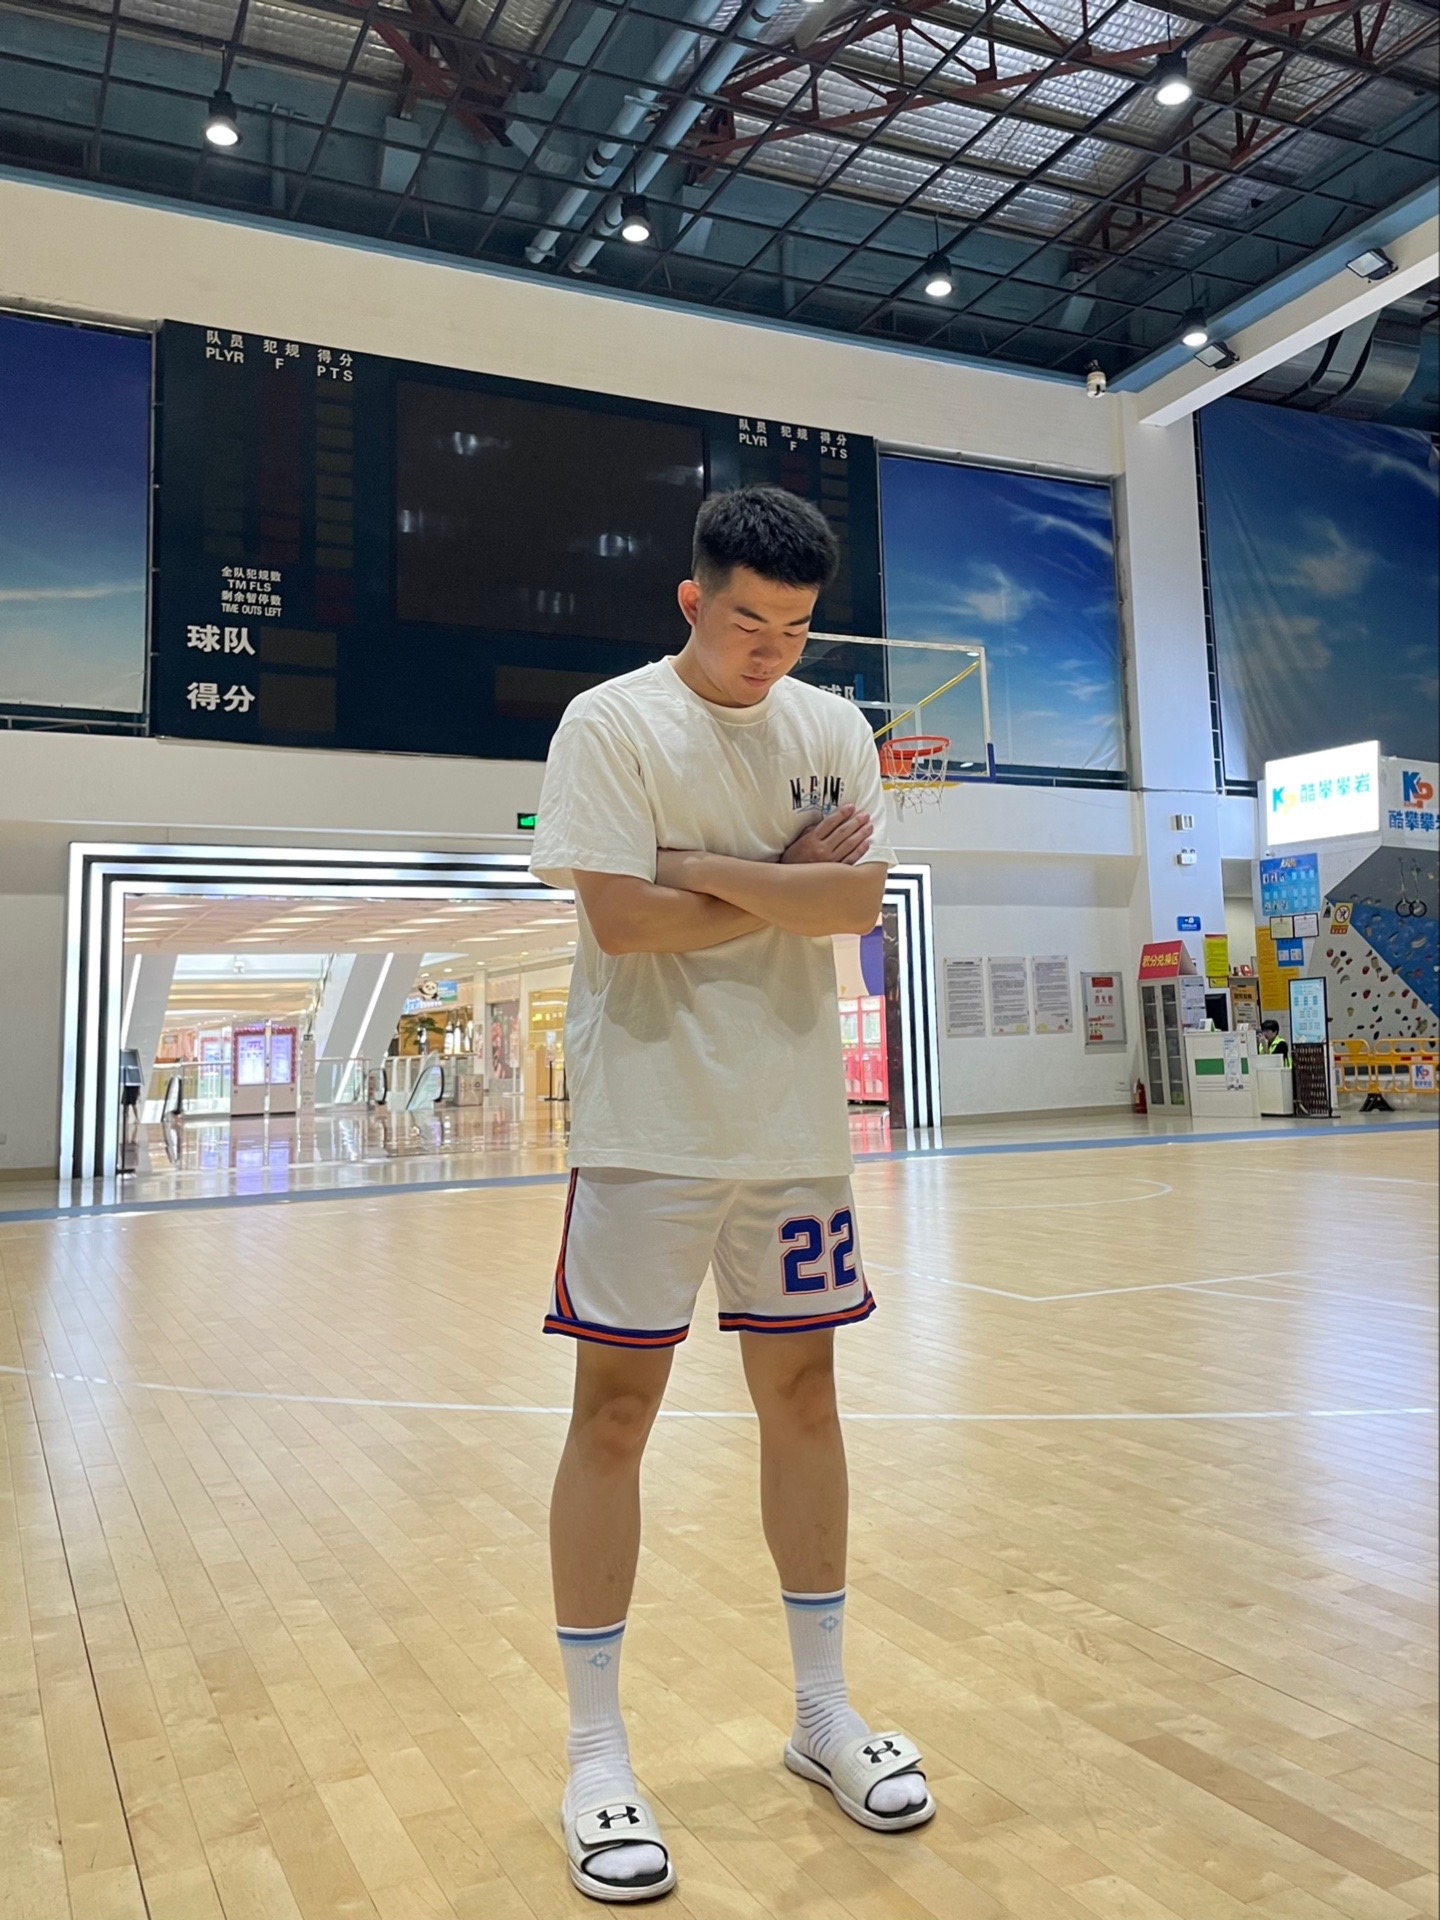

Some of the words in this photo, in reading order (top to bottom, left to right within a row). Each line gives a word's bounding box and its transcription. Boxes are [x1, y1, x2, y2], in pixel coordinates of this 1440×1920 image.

[206, 330, 244, 349] 队员
[263, 339, 300, 358] 犯规
[317, 349, 354, 367] 得分
[205, 347, 244, 364] PLYR
[275, 358, 285, 370] F
[317, 365, 354, 382] PTS
[738, 418, 767, 434] 队员
[780, 425, 809, 441] 犯规
[820, 431, 847, 446] 得分
[739, 433, 768, 447] PLYR
[790, 441, 798, 451] F
[820, 446, 848, 459] PTS
[221, 566, 282, 582] 全队犯规数
[227, 579, 247, 590] TM
[250, 582, 272, 592] FLS
[221, 590, 282, 606] 剩余暂停数
[221, 602, 239, 614] TIME
[241, 604, 263, 616] OUTS
[264, 606, 282, 618] LEFT
[187, 624, 256, 656] 球队
[186, 682, 256, 713] 得分
[1300, 772, 1371, 804] 酷攀攀岩
[779, 1206, 859, 1295] 22
